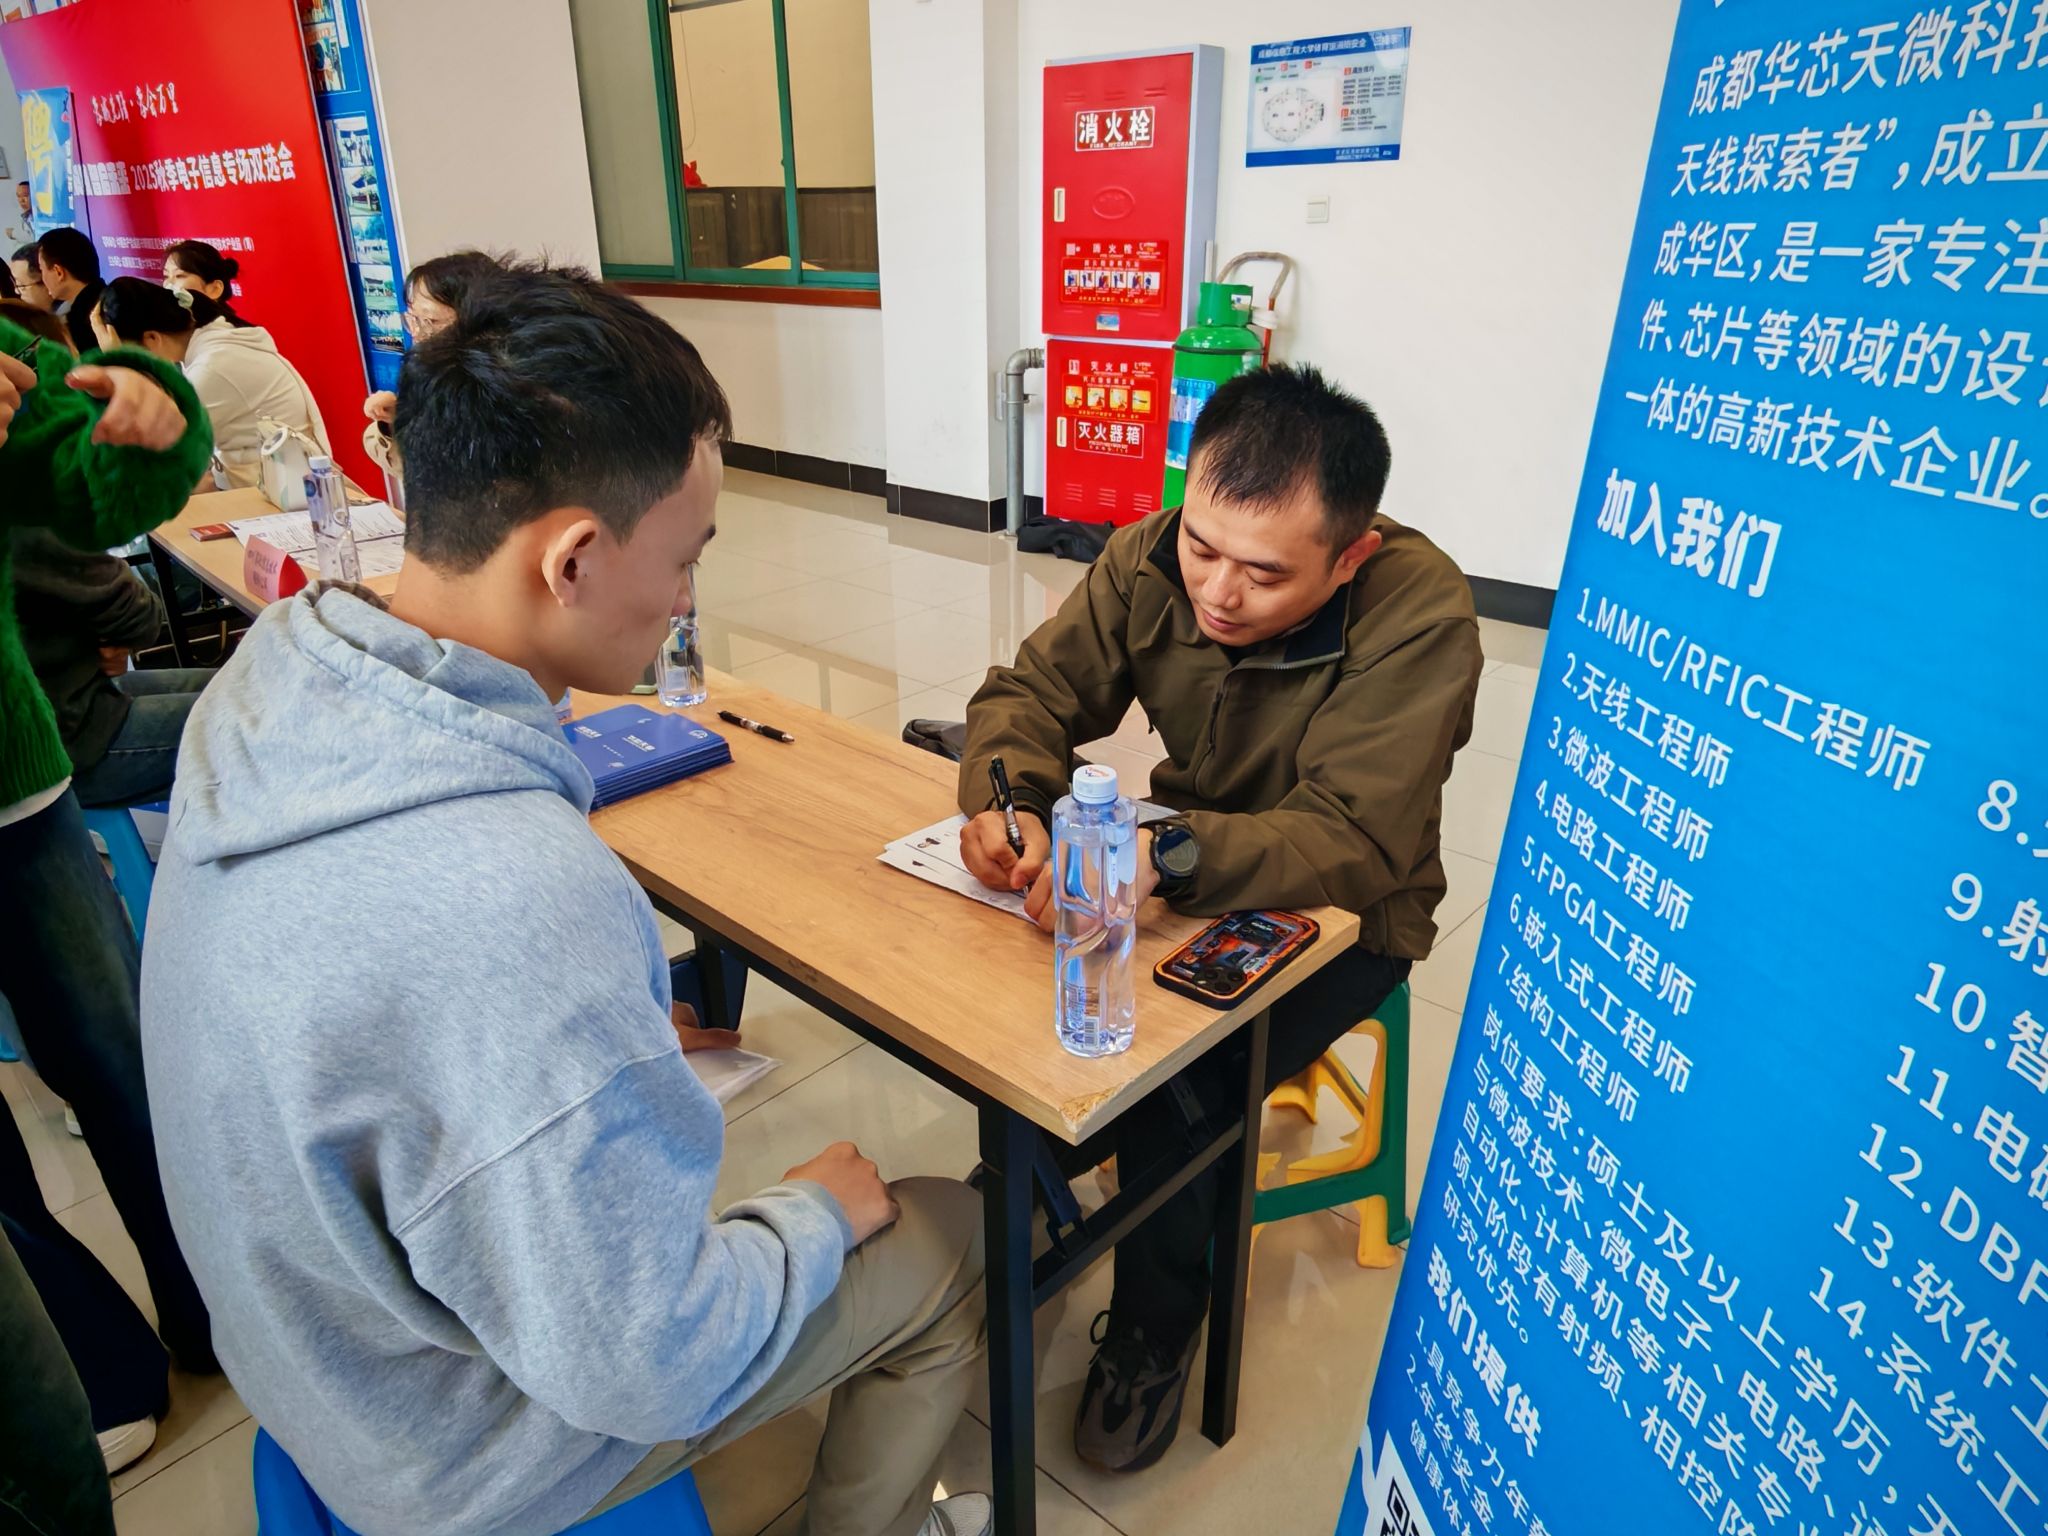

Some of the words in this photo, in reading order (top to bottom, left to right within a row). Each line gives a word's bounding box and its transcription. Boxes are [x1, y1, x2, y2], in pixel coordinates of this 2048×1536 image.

[1079, 110, 1150, 143] 消火栓
[1653, 217, 2048, 295] 成华区，是一家专注
[1638, 298, 2048, 408] 件、芯片等领域的设
[1078, 421, 1140, 445] 灭火器箱
[1625, 377, 2048, 520] 一体的高新技术企业。
[1597, 467, 1782, 598] 加入我们
[1561, 652, 1733, 789] 2.天线工程师
[1576, 587, 1931, 792] 1.MMIC/RFIC工程师
[1535, 779, 1693, 932] 4.电路工程师
[1548, 716, 1713, 862] 3.微波工程师
[1977, 779, 2048, 858] 8.
[1510, 893, 1693, 1093] 6.嵌入式工程师
[1521, 834, 1696, 1016] 5.FPGA工程师
[1498, 944, 1640, 1122] 7.结构工程师
[1443, 1180, 1529, 1344] 研究优先。
[1463, 1099, 1819, 1536] 自动化、计算机等相关专
[1427, 1242, 1541, 1458] 我们提供
[1410, 1418, 1472, 1536] 健康体
